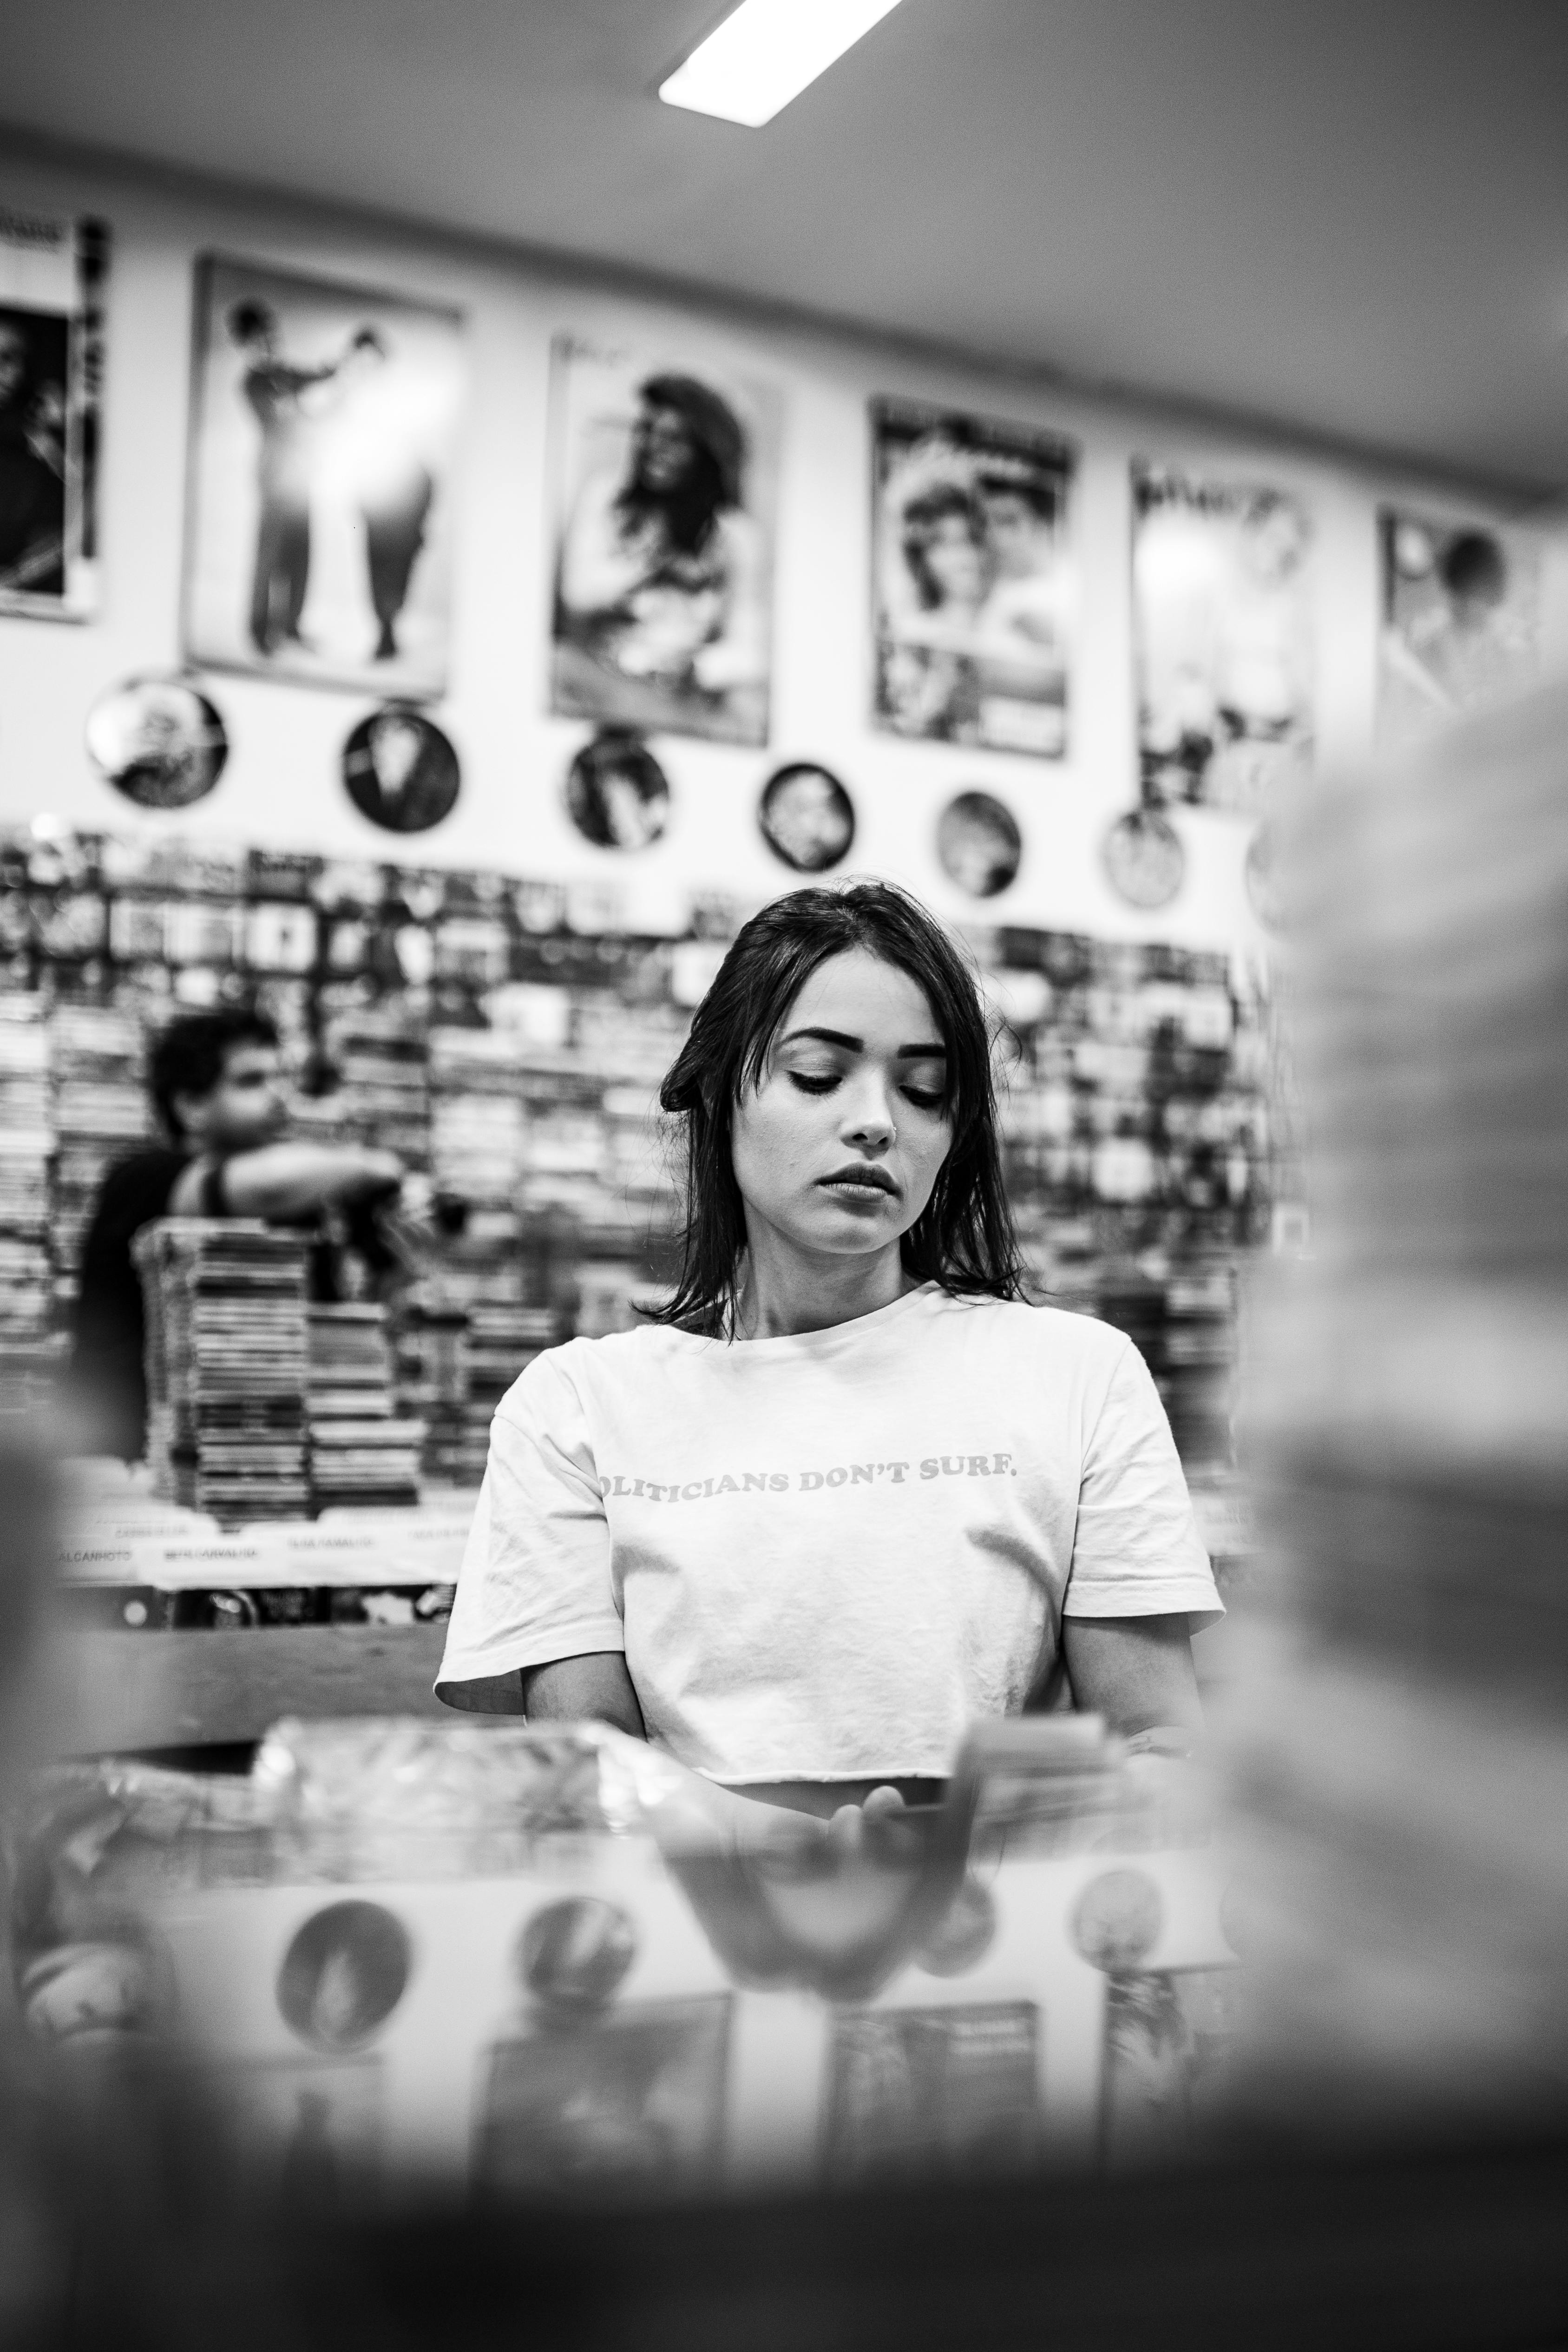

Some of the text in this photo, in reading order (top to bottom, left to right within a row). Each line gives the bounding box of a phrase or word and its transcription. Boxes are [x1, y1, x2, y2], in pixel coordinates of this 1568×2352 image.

[599, 1453, 1017, 1503] OLITICIANS DON'T SURF.
